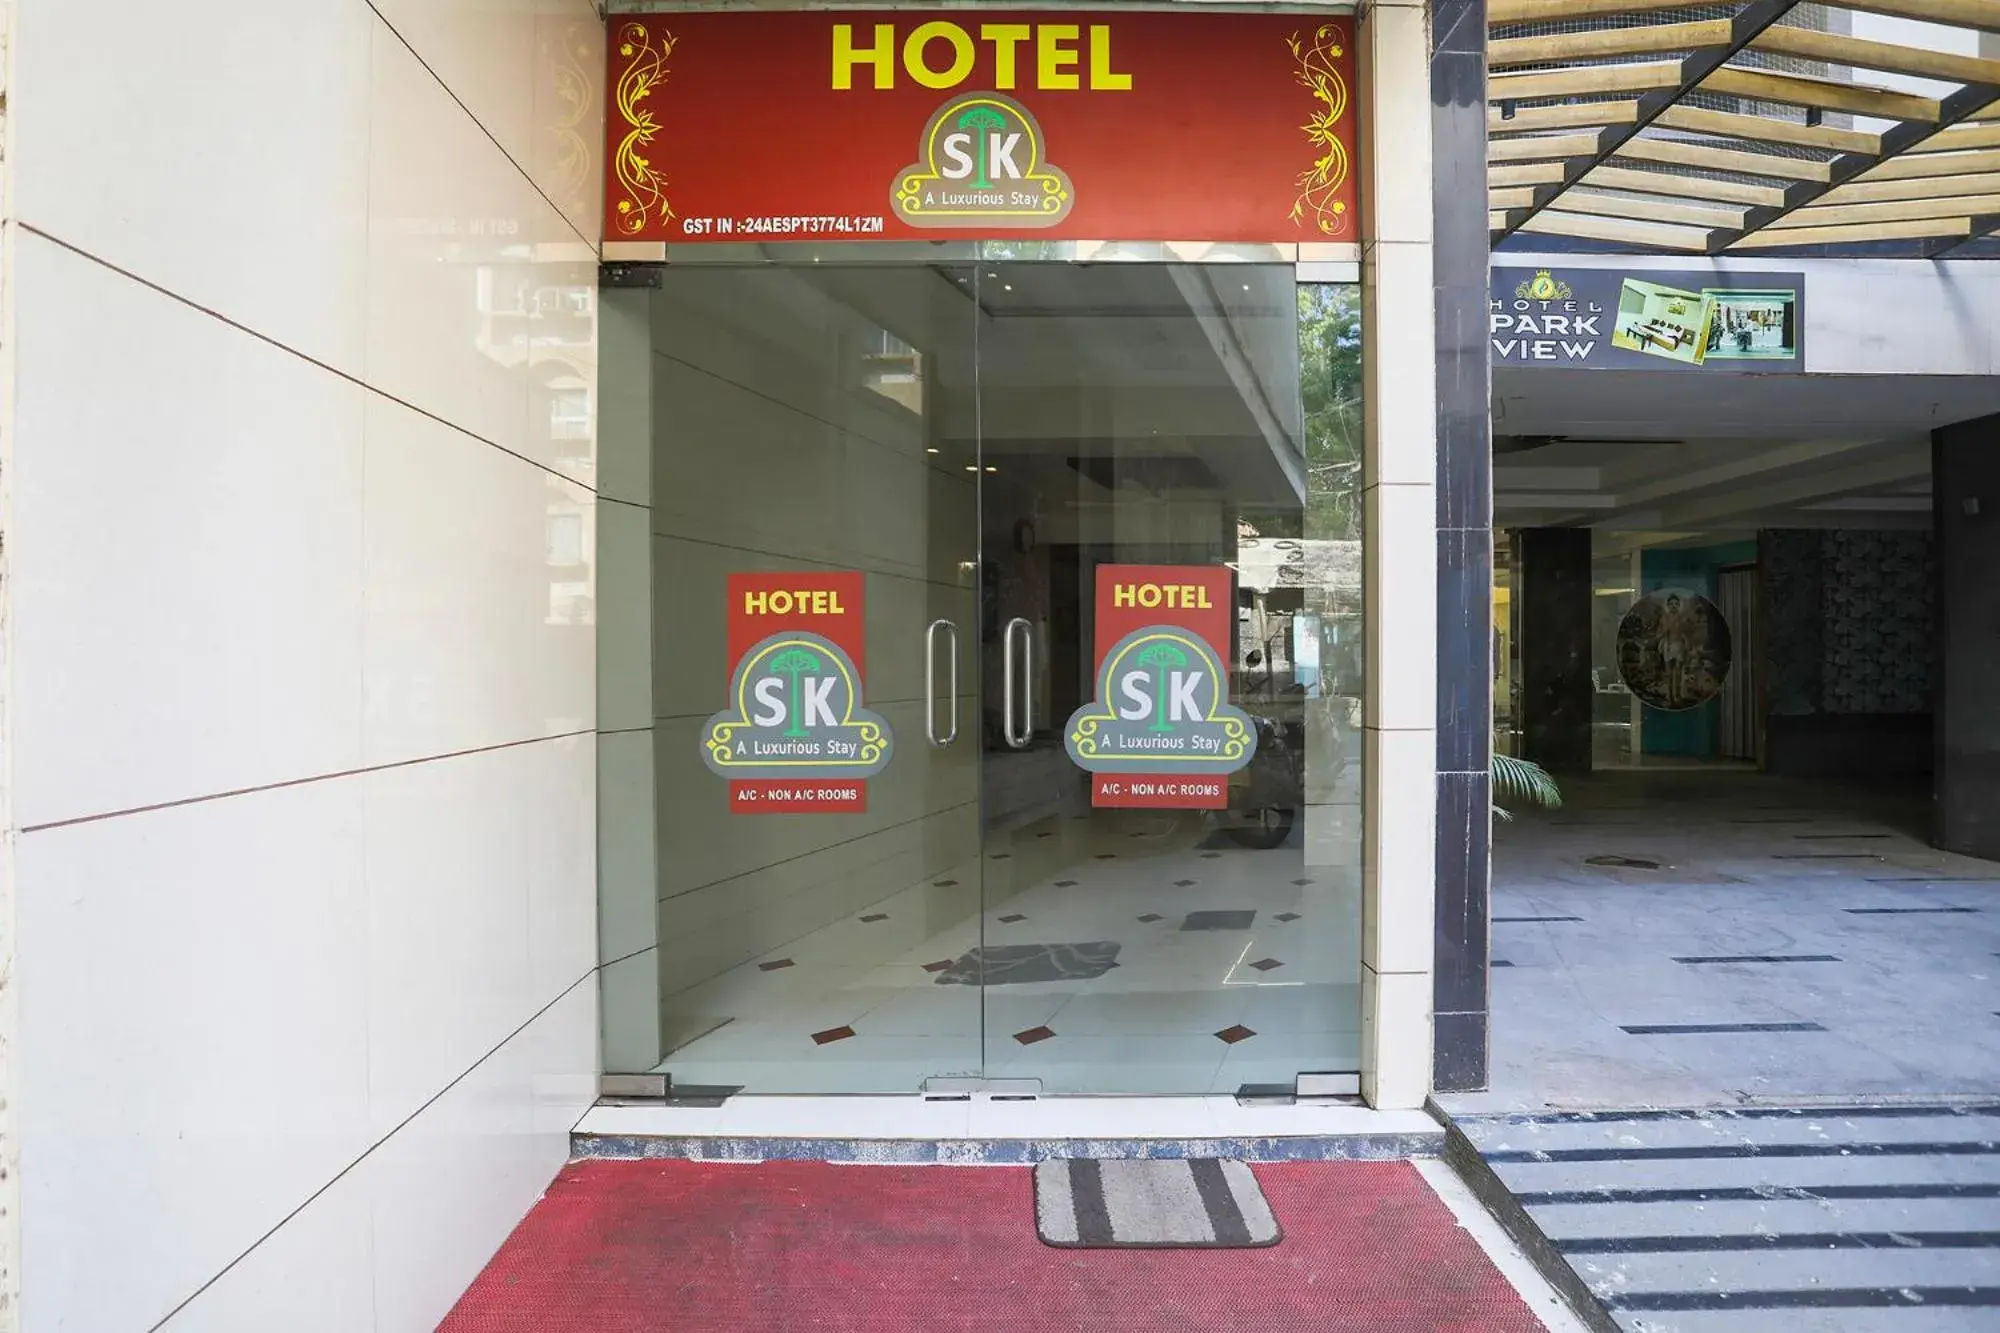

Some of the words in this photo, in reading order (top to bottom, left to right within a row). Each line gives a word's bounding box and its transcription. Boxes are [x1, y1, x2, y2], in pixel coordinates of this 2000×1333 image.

[832, 21, 1132, 90] HOTEL
[925, 192, 935, 205] A
[942, 191, 1004, 205] Luxurious
[1011, 191, 1040, 208] Stay
[683, 218, 712, 234] GST
[717, 218, 732, 234] IN
[1490, 299, 1602, 312] HOTEL
[1490, 314, 1601, 336] PARK
[1491, 339, 1596, 360] VIEW
[745, 590, 844, 615] HOTEL
[1114, 583, 1212, 609] HOTEL
[736, 741, 747, 755] A
[754, 739, 820, 755] Luxurious
[827, 740, 857, 757] Stay
[1101, 733, 1111, 748] A
[1120, 733, 1184, 749] Luxurious
[1191, 735, 1221, 753] Stay
[738, 789, 757, 801] A/C
[768, 789, 791, 801] NON
[794, 789, 814, 801] A/C
[818, 789, 857, 801] ROOMS
[1101, 783, 1120, 795] A/C
[1131, 784, 1154, 796] NON
[1157, 784, 1177, 796] A/C
[1181, 784, 1220, 796] ROOMS
